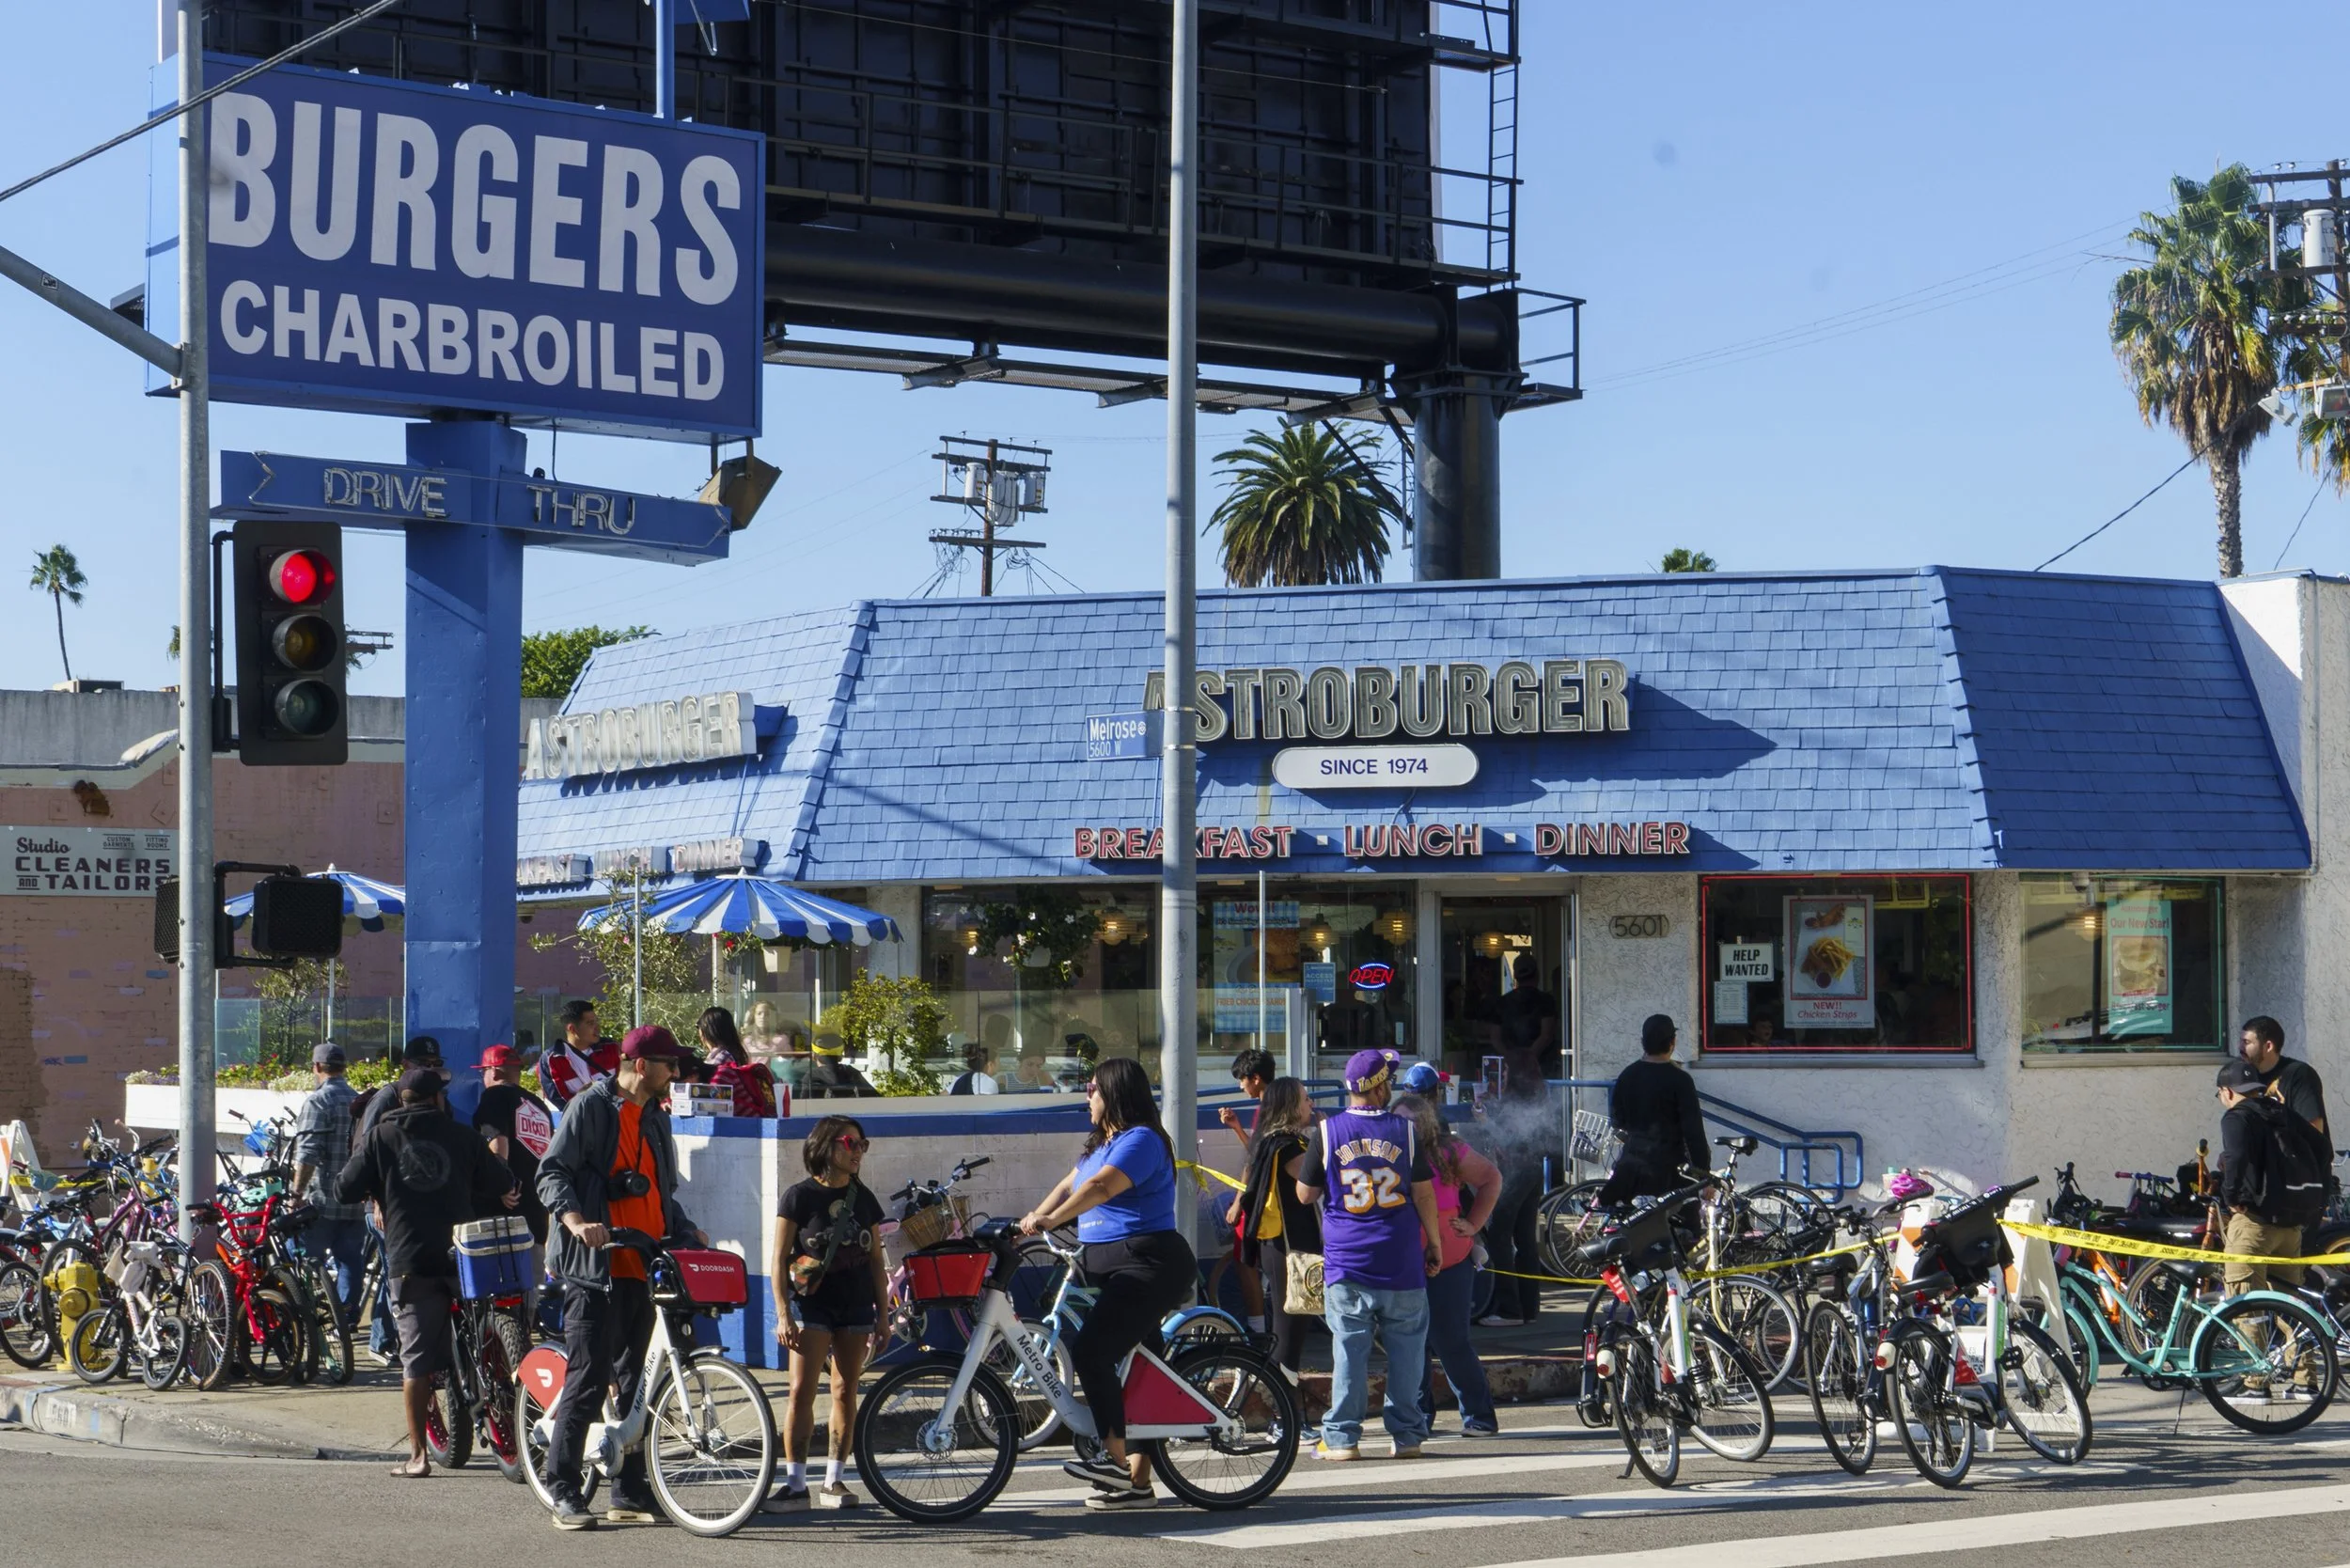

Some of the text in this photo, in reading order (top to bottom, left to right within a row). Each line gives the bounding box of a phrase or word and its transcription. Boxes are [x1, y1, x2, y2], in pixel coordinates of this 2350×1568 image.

[208, 92, 741, 306] BURGERS
[221, 280, 724, 400] CHARBROILED
[324, 468, 635, 534] DRIVE THRU
[526, 691, 745, 781] ASTROBURGER
[1090, 717, 1136, 741] Melrose
[1090, 741, 1121, 757] 5600 W
[1320, 759, 1428, 775] SINCE 1974
[16, 837, 70, 854] Studio
[1073, 822, 1689, 858] BREAFAST LUNCH DINNER
[15, 856, 170, 873] CLEANERS
[19, 878, 38, 886] AND
[1615, 917, 1662, 937] 5601
[1733, 949, 1760, 961] HELP
[1349, 968, 1394, 984] OPEN
[1725, 964, 1768, 976] WANTED
[1833, 1010, 1857, 1019] Strips
[1335, 1138, 1402, 1166] JOHNSON
[1340, 1167, 1406, 1214] 32
[700, 1264, 734, 1273] DOORDASH
[1017, 1335, 1062, 1399] Metro Bike
[634, 1352, 657, 1413] Metro Bike
